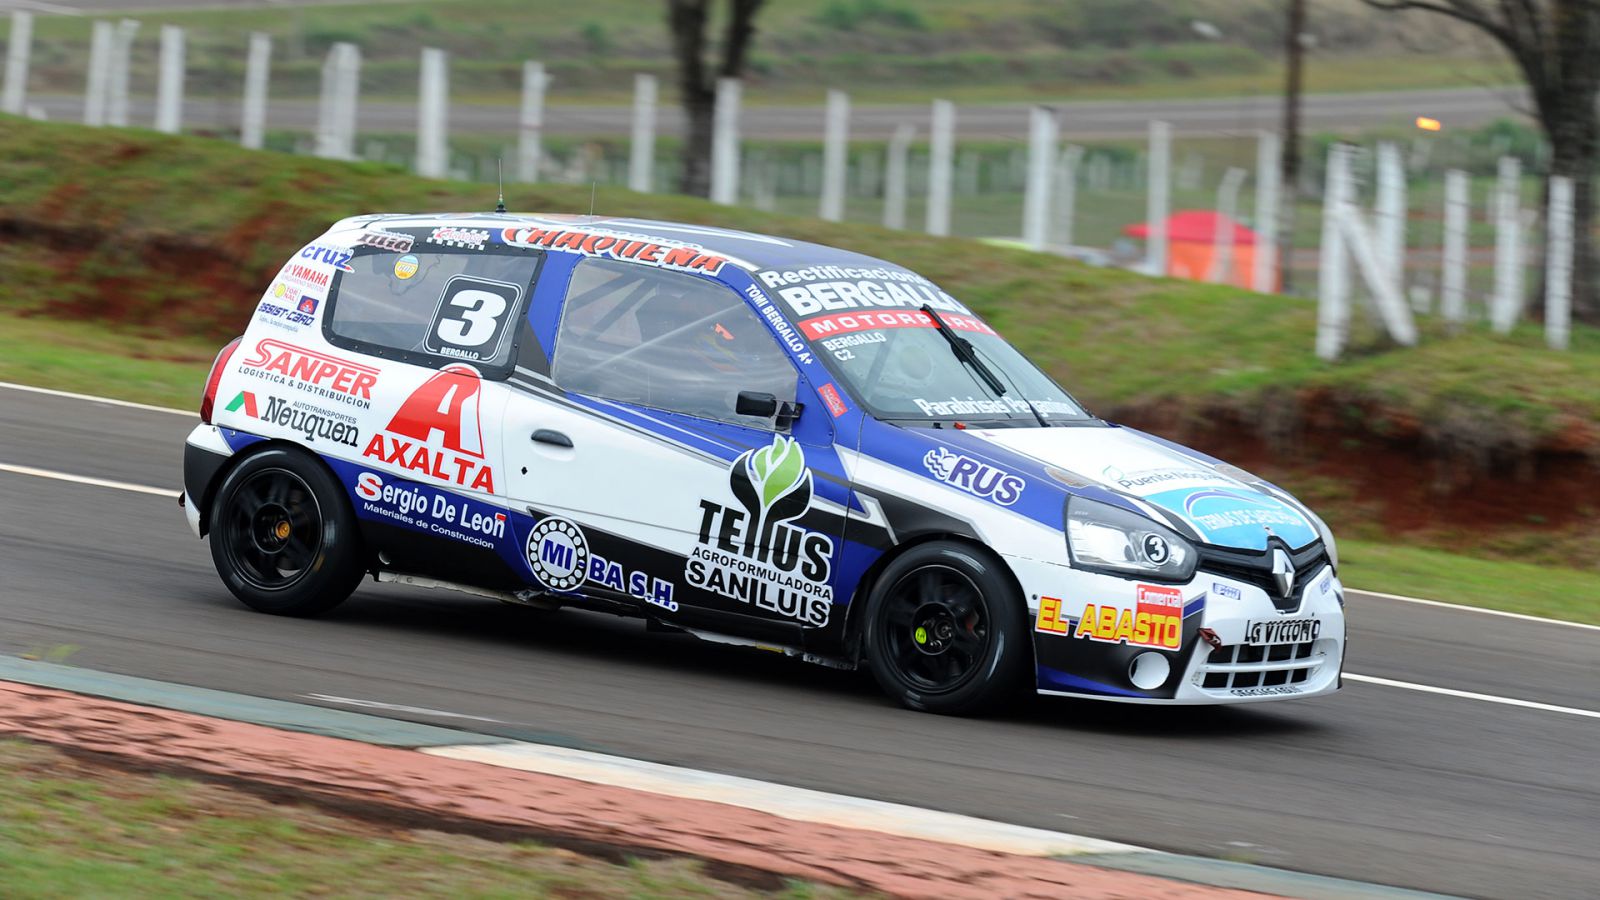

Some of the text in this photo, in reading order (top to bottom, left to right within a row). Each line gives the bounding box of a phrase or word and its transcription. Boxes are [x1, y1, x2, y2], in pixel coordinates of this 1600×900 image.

[503, 227, 728, 273] CHAQUEÑA
[292, 265, 328, 287] YAMAHA
[777, 279, 971, 317] BERGALLO
[437, 289, 506, 346] 3
[745, 283, 767, 307] TOMI
[762, 304, 803, 353] BERGALLO
[441, 347, 479, 359] BERGALLO
[822, 331, 886, 353] BERGALLO
[834, 350, 856, 363] C2
[239, 366, 370, 410] LOGISTICA & DISTRIBUICION
[243, 338, 381, 400] SANPER
[261, 395, 359, 447] Neuquen
[293, 400, 357, 424] AUTOTRANSPORTES
[363, 433, 494, 494] AXALTA
[949, 456, 1025, 506] RUS
[355, 472, 428, 514] Sergio
[432, 496, 456, 523] De
[363, 502, 494, 549] Materiales de Construccion
[541, 538, 573, 571] MI
[691, 546, 832, 600] AGROFORMULADORA
[1149, 537, 1165, 562] 3
[686, 559, 831, 627] SAN LUIS
[1035, 595, 1181, 650] EL ABASTO
